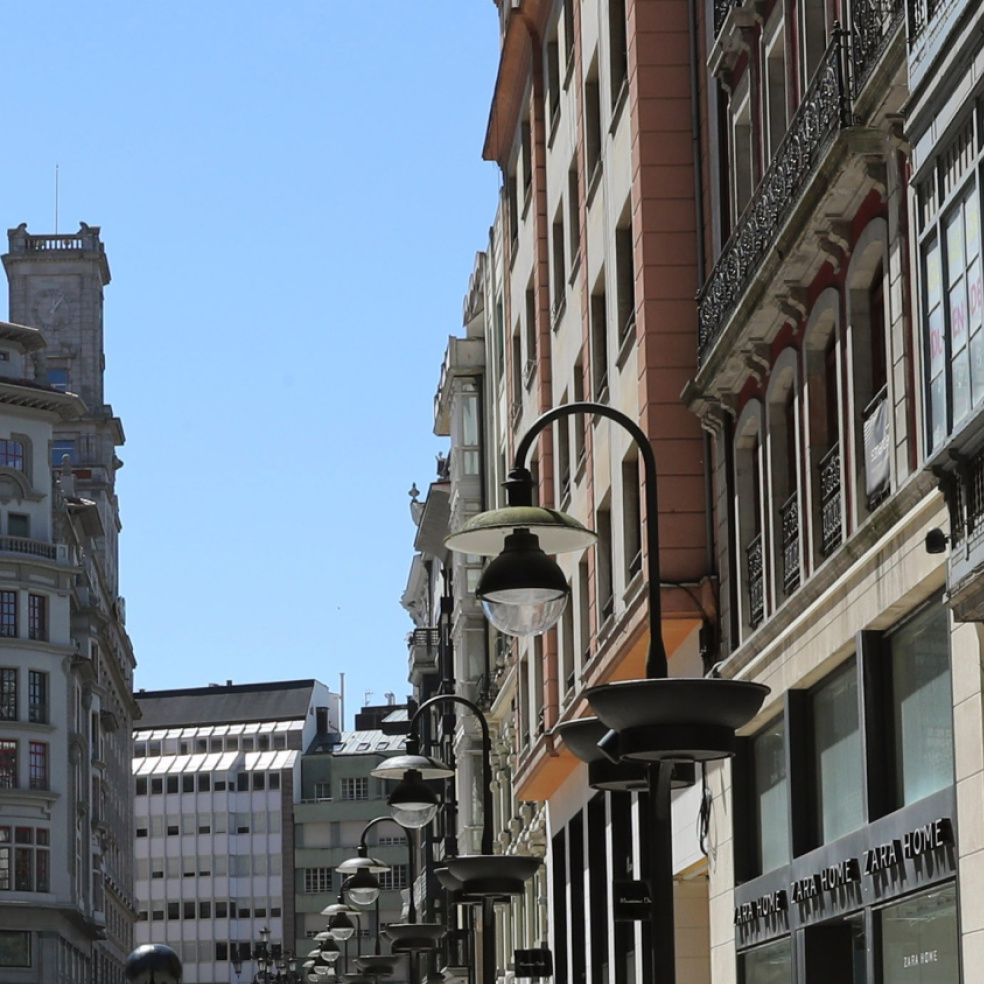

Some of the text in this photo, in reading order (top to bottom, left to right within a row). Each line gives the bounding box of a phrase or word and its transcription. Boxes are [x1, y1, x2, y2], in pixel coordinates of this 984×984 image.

[863, 818, 947, 876] ZARA HOME
[791, 858, 855, 904] ZARA HOME
[756, 889, 784, 917] HOME
[903, 950, 938, 968] ZARA HOME
